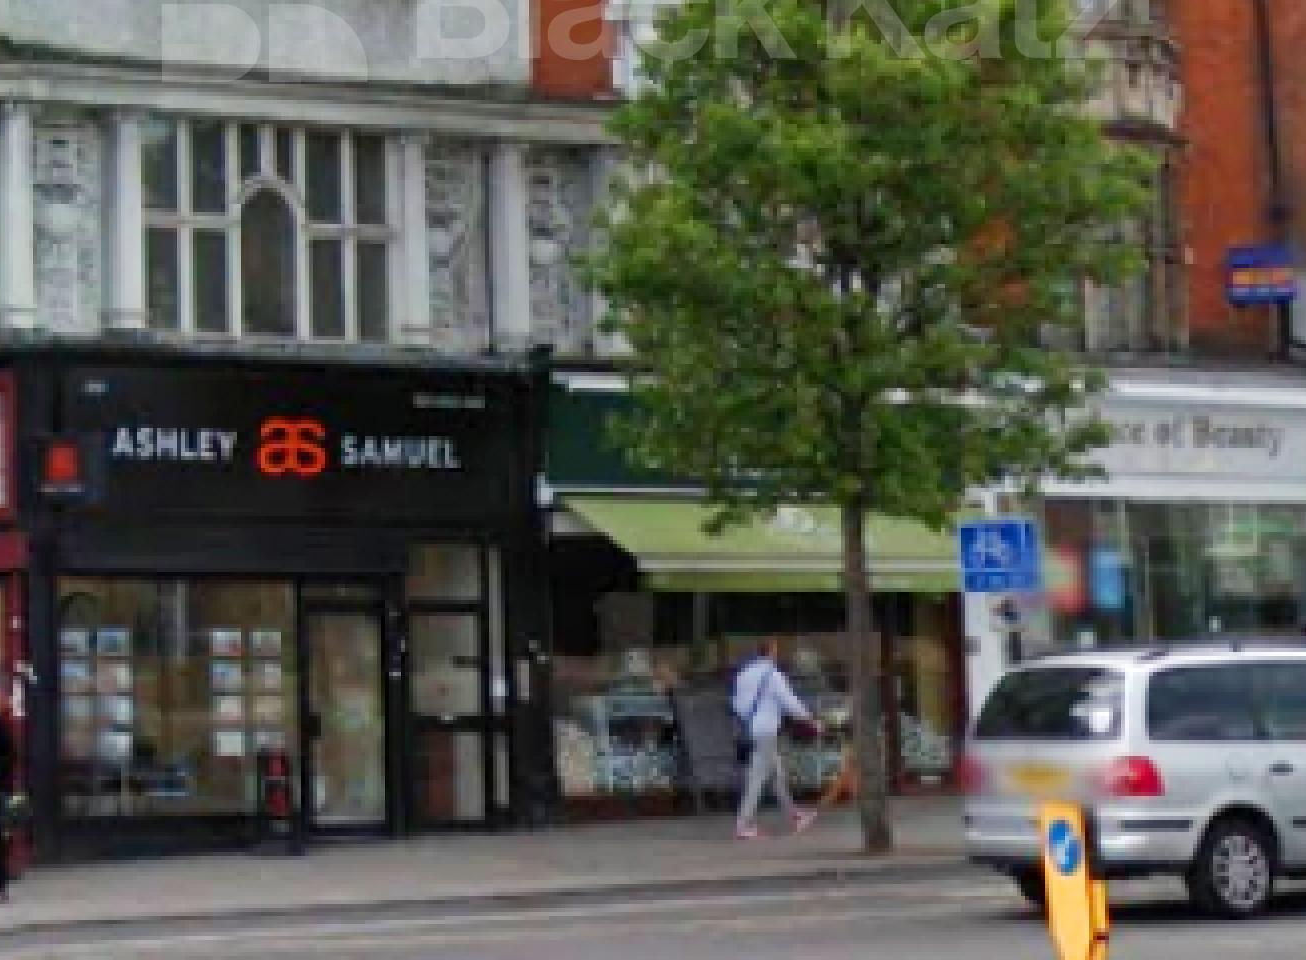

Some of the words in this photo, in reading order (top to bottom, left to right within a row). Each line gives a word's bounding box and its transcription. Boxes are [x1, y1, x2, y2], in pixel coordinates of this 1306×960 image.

[112, 426, 238, 460] ASHLEY
[341, 436, 462, 470] SAMUEL
[1154, 416, 1182, 448] of
[1192, 416, 1283, 456] Beauty
